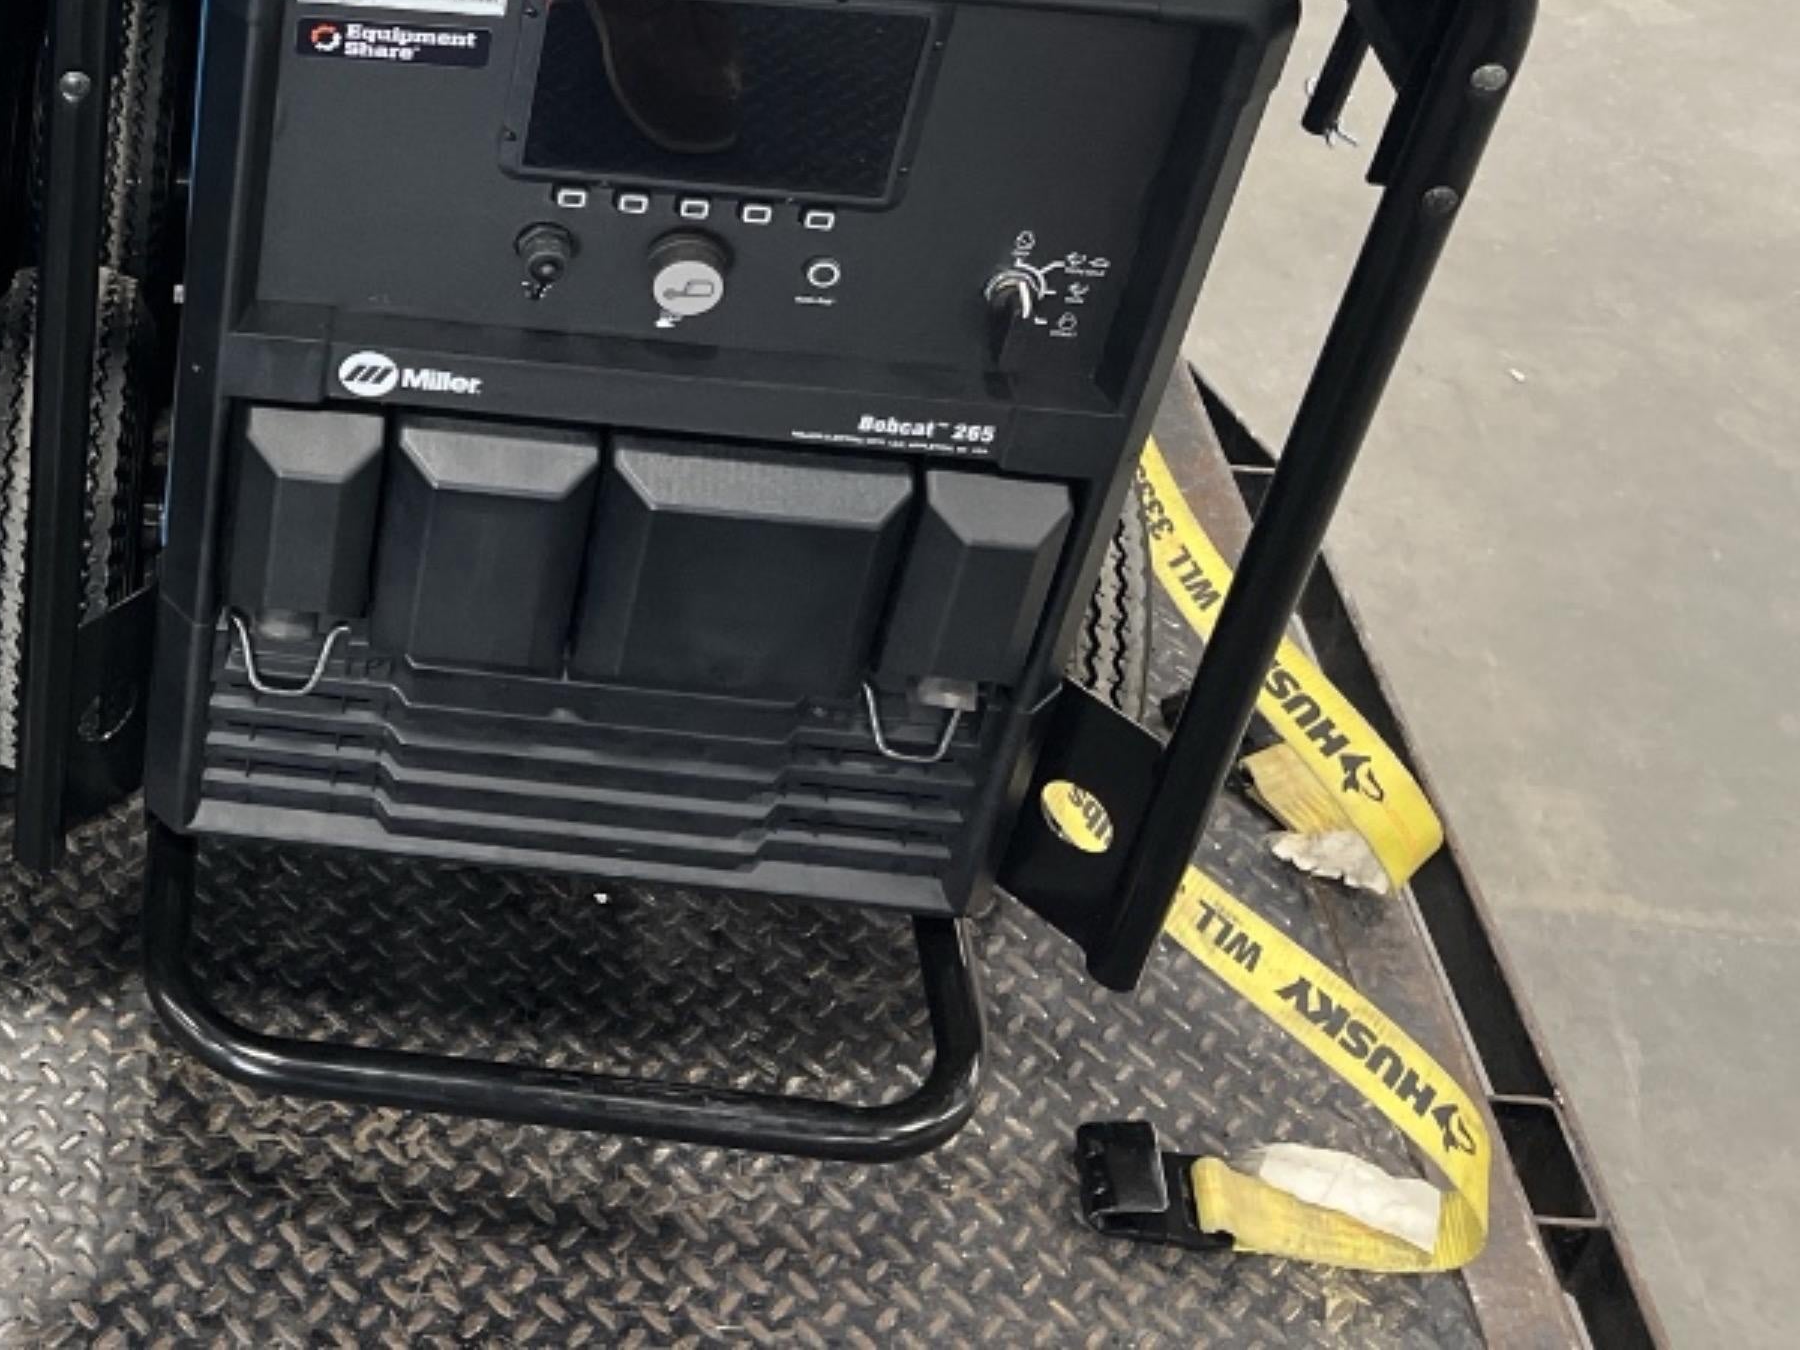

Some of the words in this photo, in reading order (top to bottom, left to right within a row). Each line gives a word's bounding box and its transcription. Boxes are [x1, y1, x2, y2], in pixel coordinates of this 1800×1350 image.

[344, 23, 478, 48] Equipment
[951, 422, 997, 443] 265
[1168, 543, 1222, 612] WLL
[1264, 662, 1350, 756] HUS
[1196, 898, 1263, 973] WLL
[1276, 976, 1436, 1117] HUSKY
